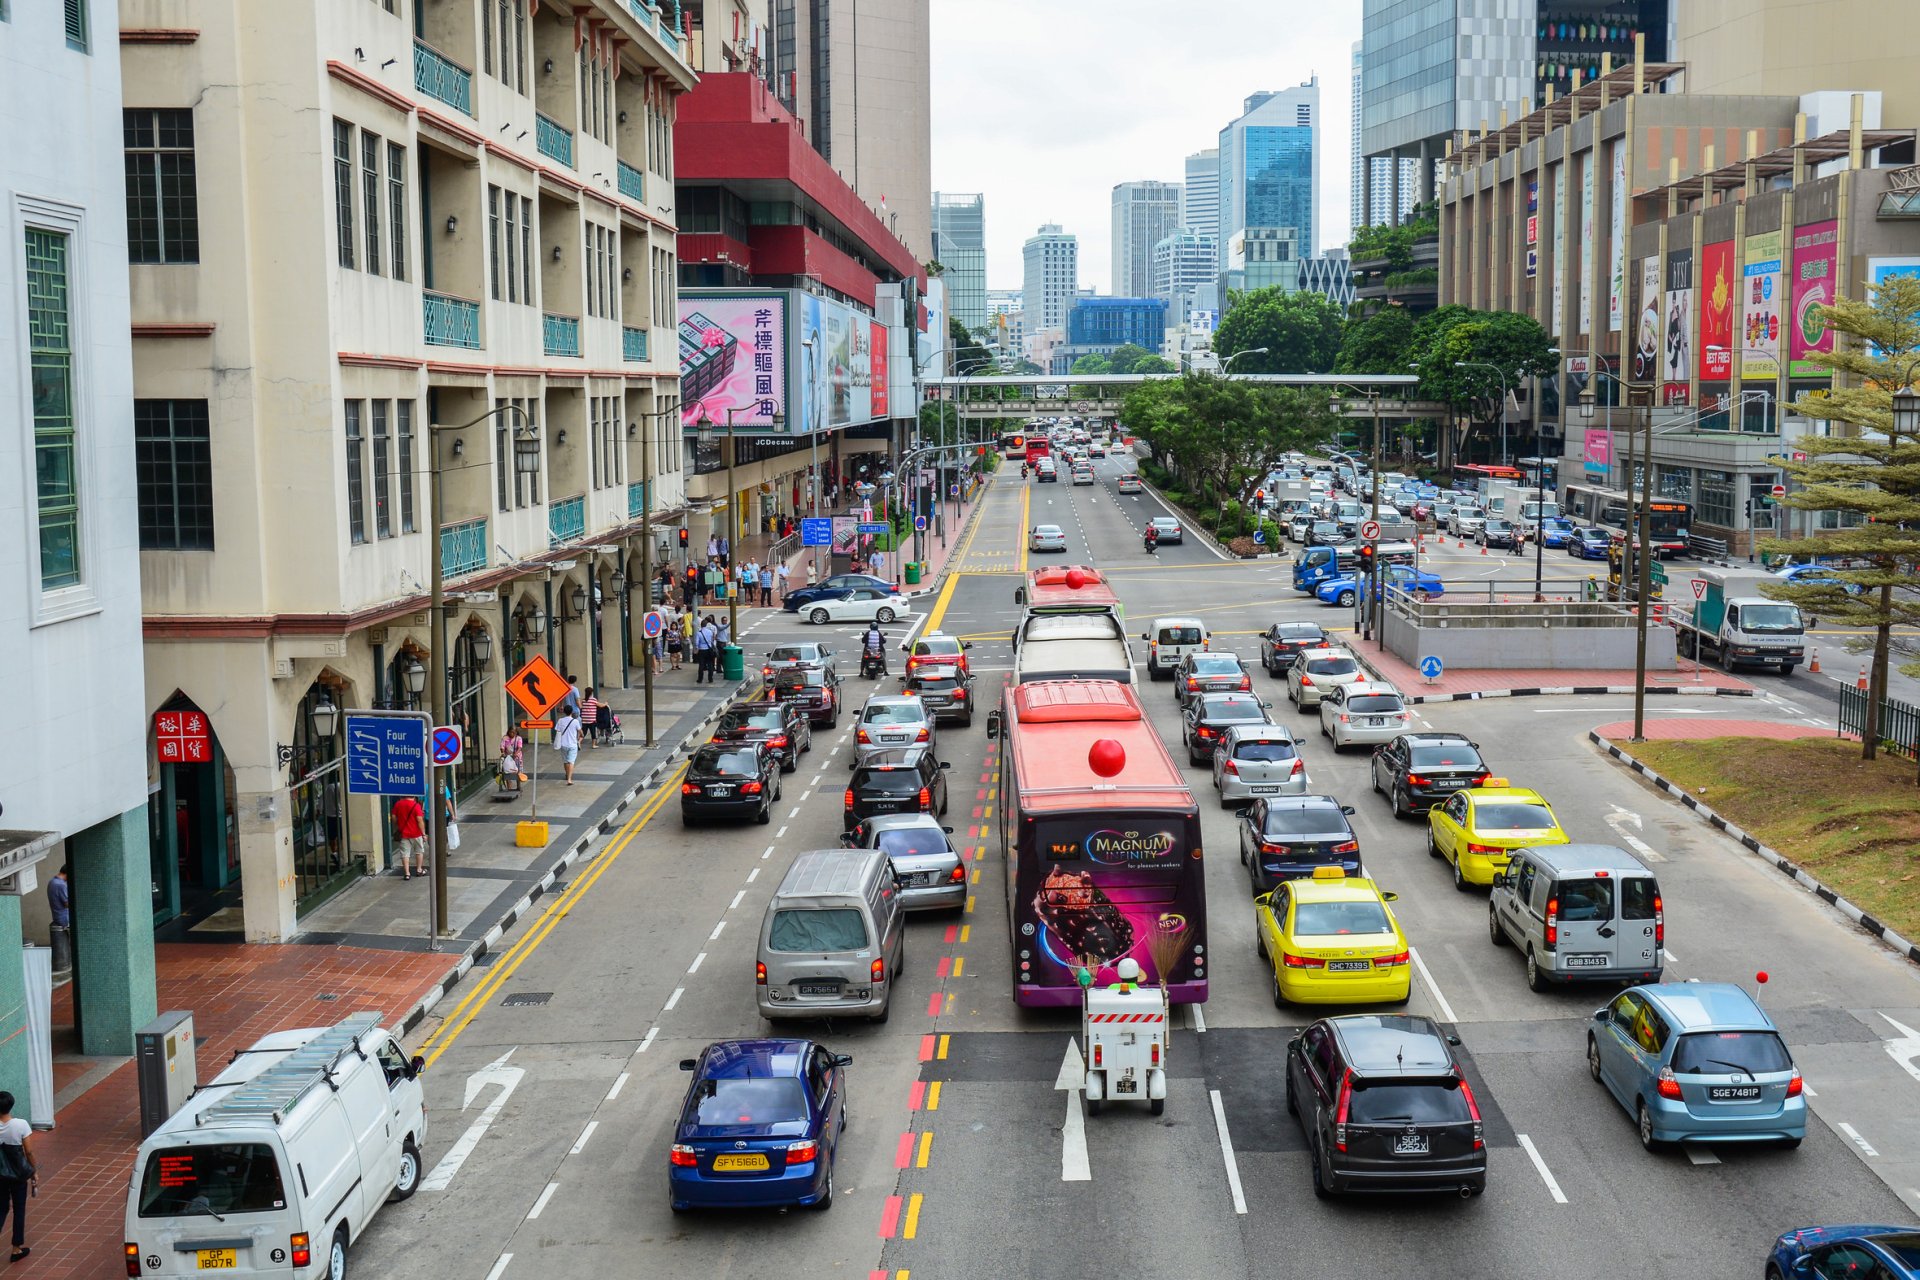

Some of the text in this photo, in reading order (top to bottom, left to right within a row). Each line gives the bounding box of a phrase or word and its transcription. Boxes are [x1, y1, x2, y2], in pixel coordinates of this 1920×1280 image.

[754, 308, 773, 416] 斧標驅風油
[1571, 359, 1586, 371] Bata
[159, 714, 202, 735] 裕華
[386, 729, 407, 740] Four
[163, 740, 203, 758] 國貨
[387, 744, 421, 758] Waiting
[387, 759, 415, 770] Lanes
[388, 773, 416, 784] Ahead
[1096, 837, 1168, 851] MAGNUM
[1105, 851, 1158, 860] INFINITY
[1158, 919, 1179, 929] NEW
[1329, 962, 1344, 970] SHC
[1713, 1089, 1759, 1097] SGE 7481P
[717, 1158, 736, 1167] SFY
[736, 1158, 757, 1167] 5166
[209, 1251, 223, 1259] GP
[275, 1250, 281, 1258] 8
[148, 1257, 160, 1265] 70
[201, 1259, 224, 1268] 1807
